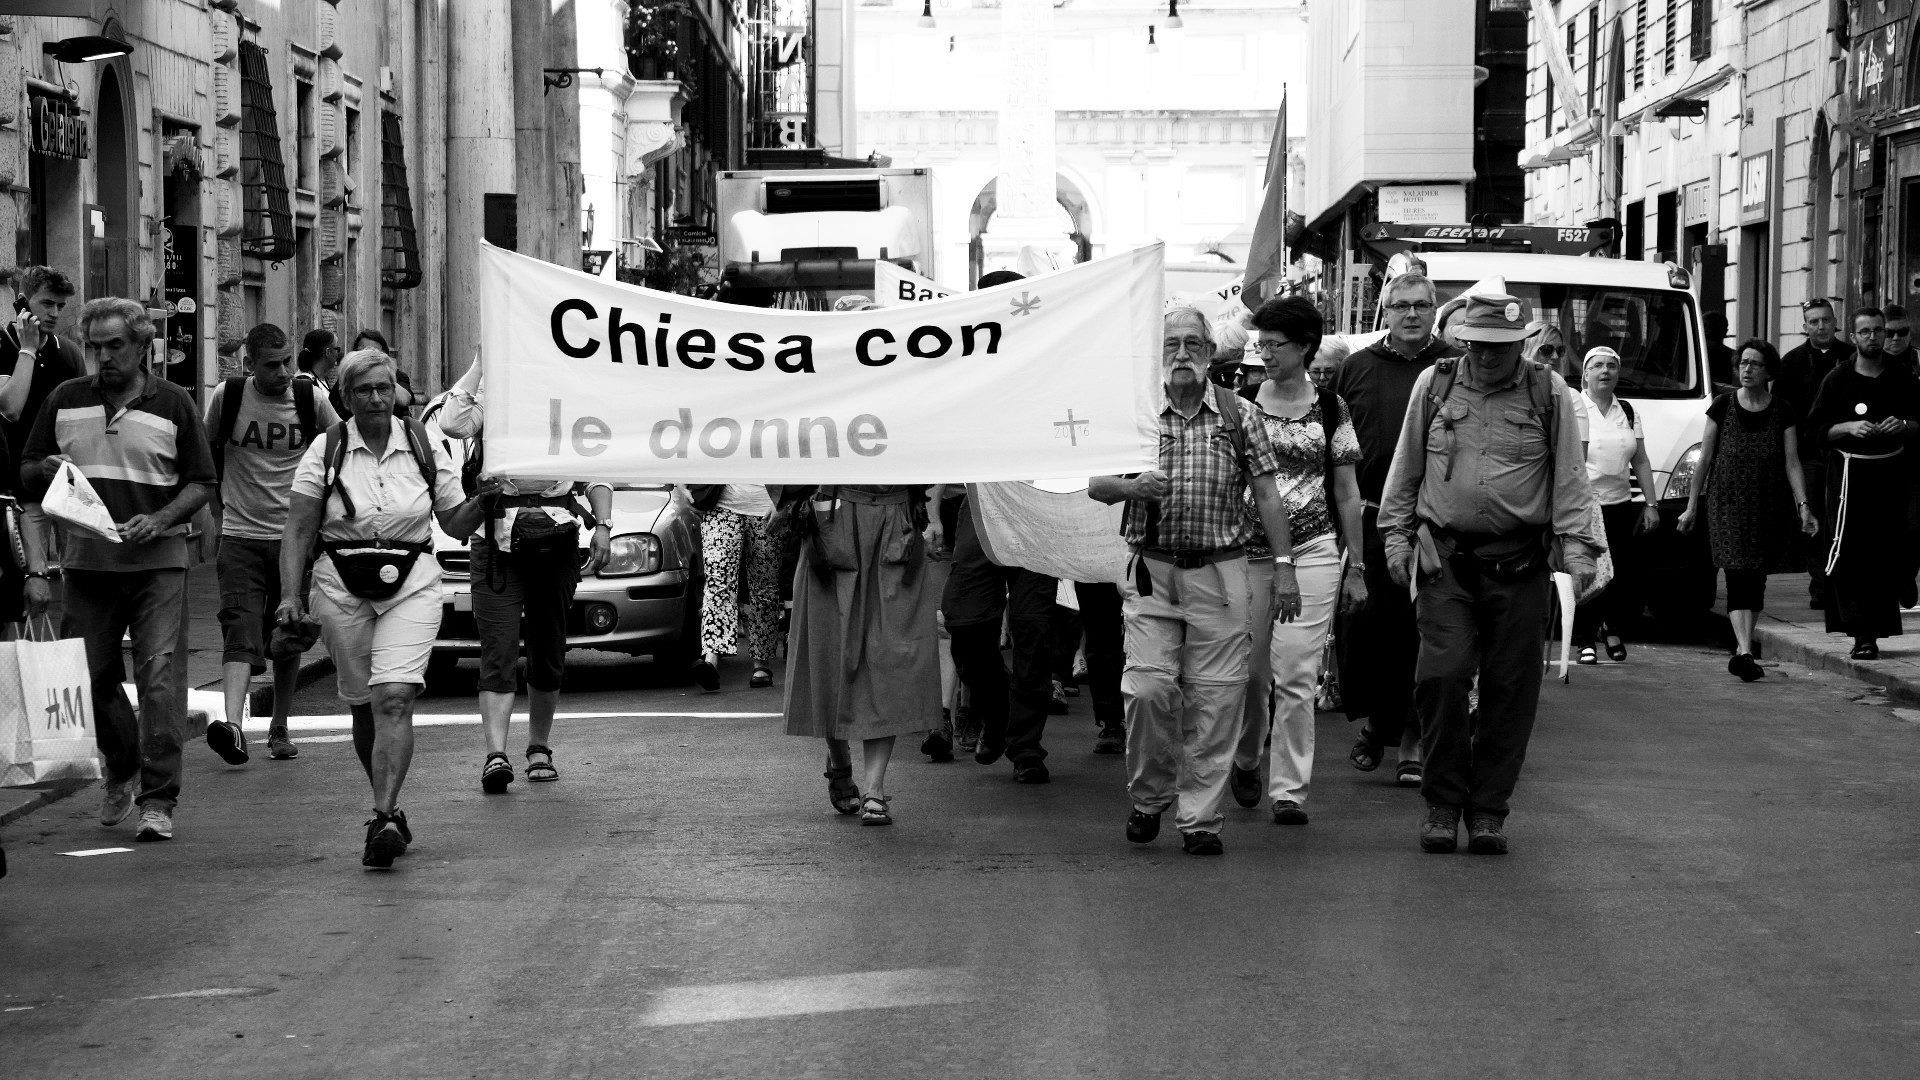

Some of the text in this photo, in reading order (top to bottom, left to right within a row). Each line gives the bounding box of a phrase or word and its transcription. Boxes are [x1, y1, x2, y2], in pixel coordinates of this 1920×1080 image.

[37, 96, 88, 158] Gelateria
[1557, 228, 1591, 242] F527
[550, 298, 1003, 374] Chiesa con
[548, 397, 890, 460] le donne
[44, 685, 86, 731] H&M
